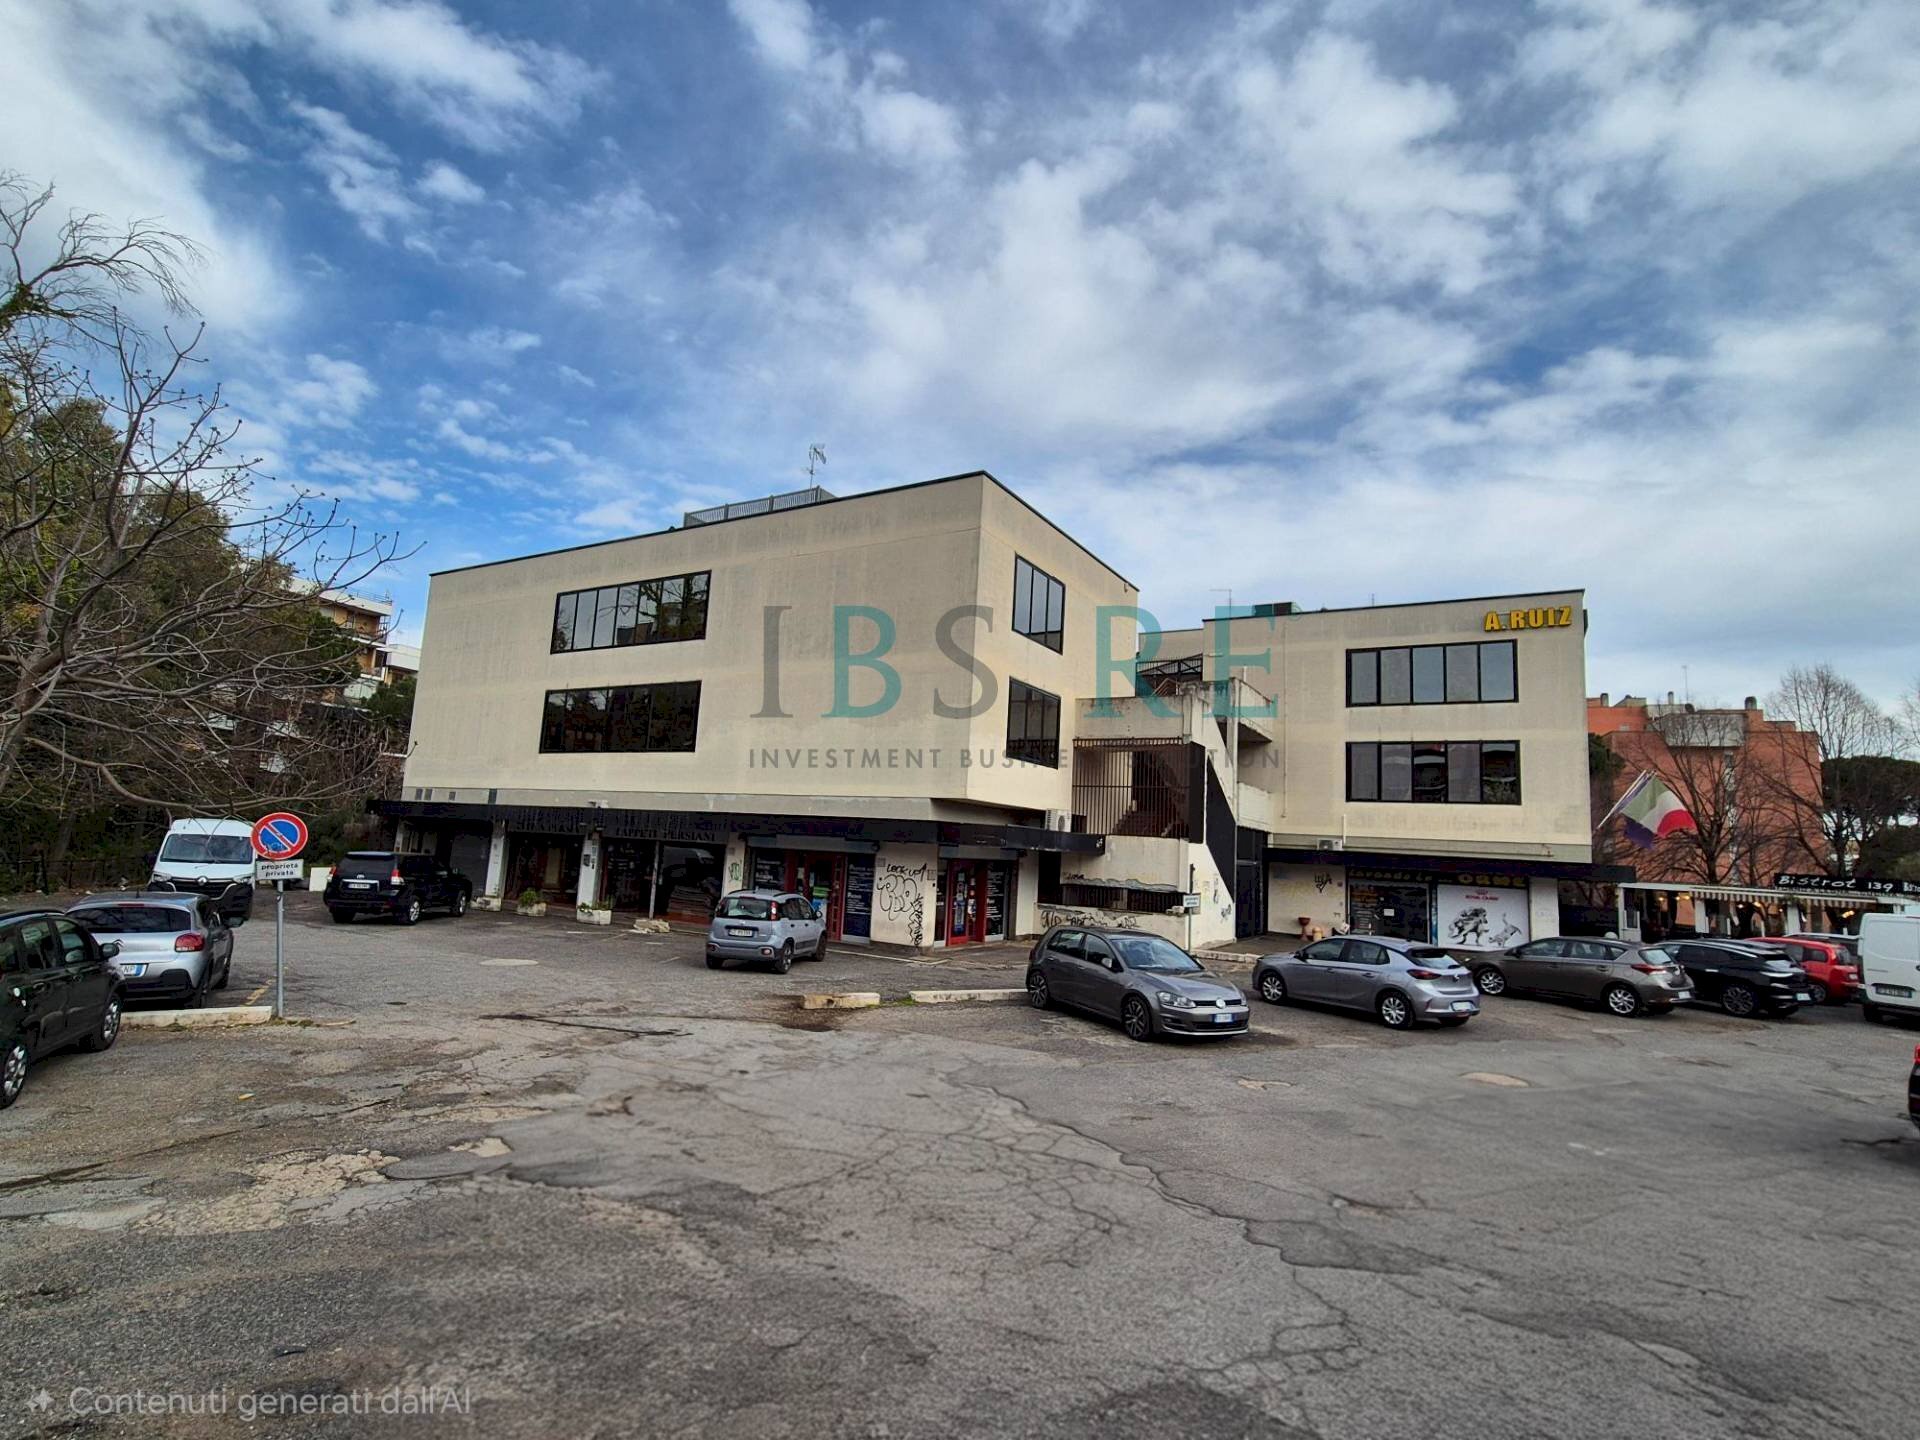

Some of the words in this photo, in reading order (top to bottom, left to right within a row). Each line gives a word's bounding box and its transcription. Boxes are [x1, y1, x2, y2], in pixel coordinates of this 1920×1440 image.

[265, 869, 294, 878] privata
[1778, 874, 1857, 889] Bistrot
[1868, 881, 1894, 893] 139
